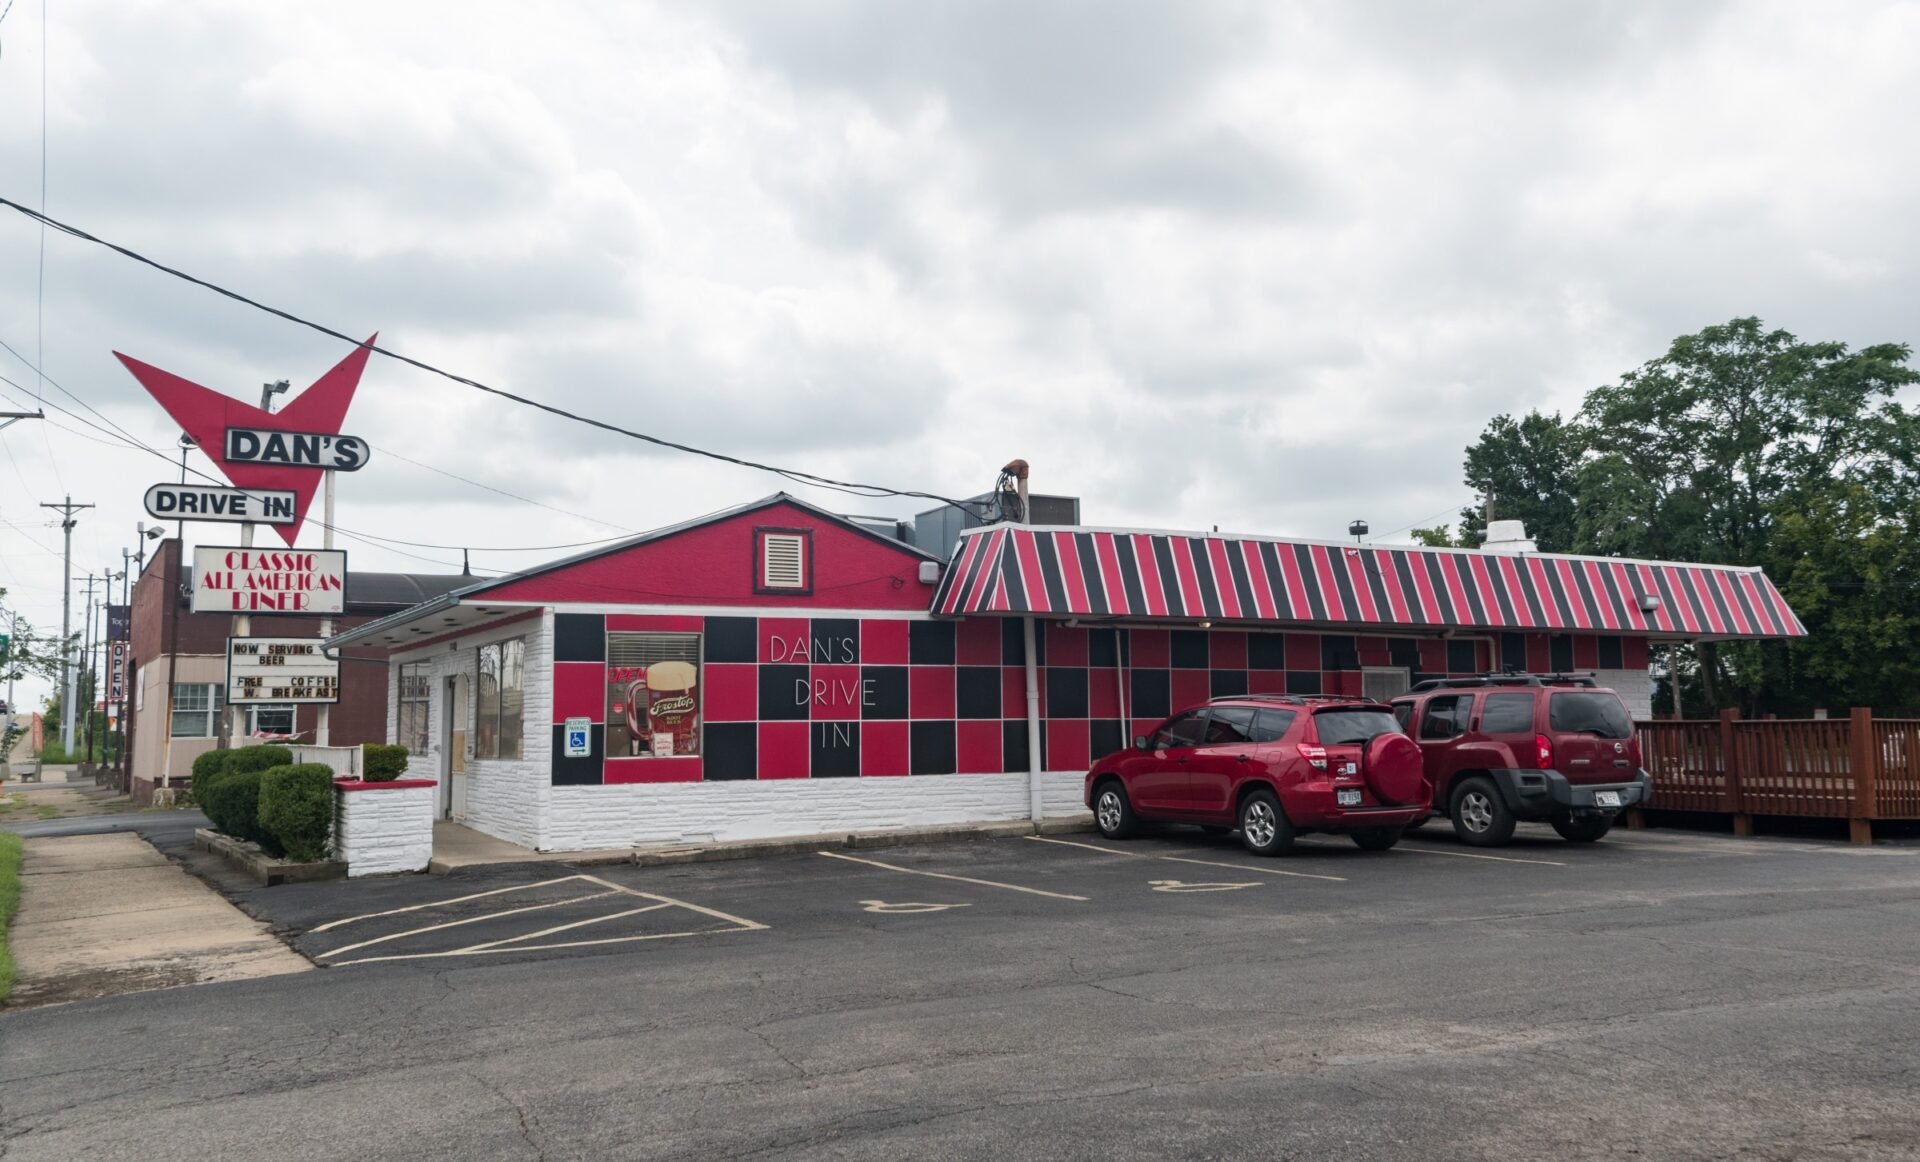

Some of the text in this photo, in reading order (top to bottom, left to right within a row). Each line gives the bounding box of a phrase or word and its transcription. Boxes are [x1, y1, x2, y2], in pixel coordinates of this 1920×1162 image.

[231, 431, 359, 467] DAN'S
[156, 491, 291, 517] DRIVE IN
[225, 552, 319, 572] CLASSIC
[201, 571, 341, 591] ALL AMERICAN
[232, 592, 310, 611] DINER
[234, 644, 313, 655] NOW SERVING
[771, 635, 854, 663] DAN'S
[112, 645, 123, 697] OPEN
[259, 656, 285, 666] BEER
[237, 676, 337, 688] FREE COFFEE
[608, 667, 648, 683] OPEN
[796, 679, 876, 705] DRIVE
[823, 722, 850, 749] IN
